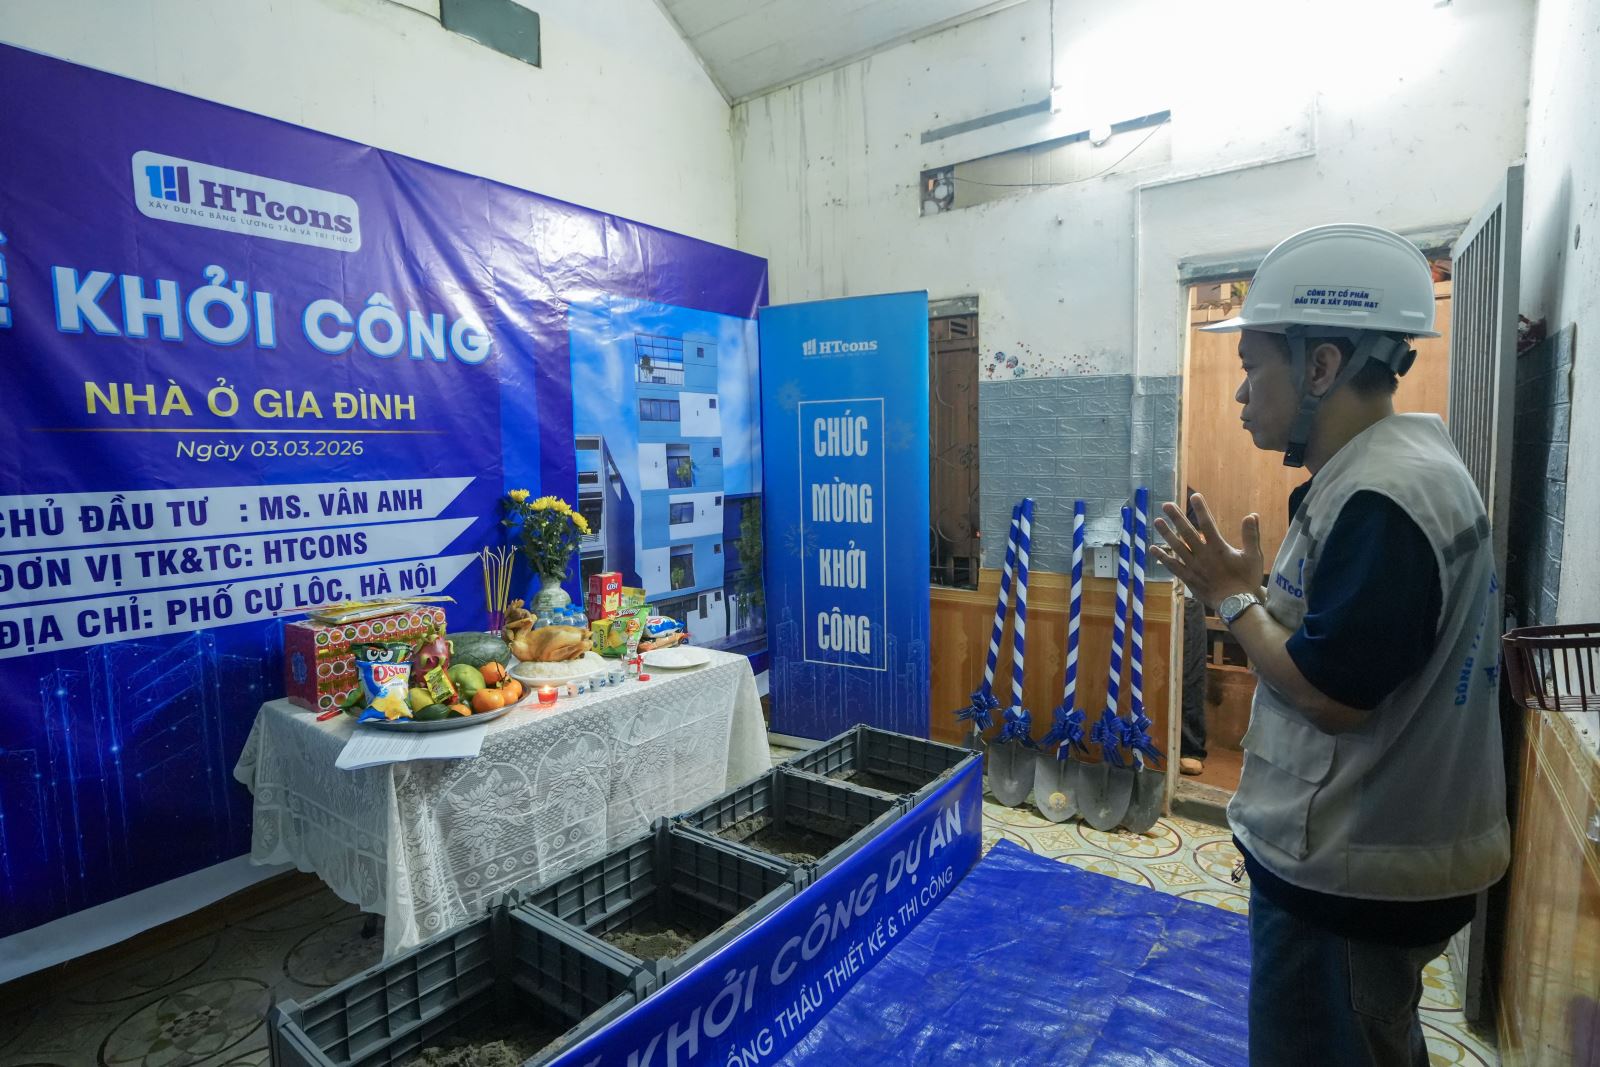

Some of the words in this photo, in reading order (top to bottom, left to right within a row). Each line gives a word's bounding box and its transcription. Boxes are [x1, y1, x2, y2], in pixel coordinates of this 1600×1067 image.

[198, 178, 353, 234] HTcons
[52, 264, 277, 349] KHỞI
[303, 292, 493, 365] CÔNG
[1306, 288, 1326, 297] CÔNG
[818, 339, 878, 354] HTcons
[84, 379, 194, 418] NHÀ
[206, 377, 240, 418] Ở
[253, 387, 323, 420] GIA
[332, 388, 416, 421] ĐÌNH
[176, 440, 245, 463] Ngày
[250, 440, 364, 458] 03.03.2026
[813, 409, 869, 458] CHÚC
[0, 498, 64, 538] HỦ
[79, 494, 155, 533] ĐẦU
[167, 496, 210, 527] TƯ
[259, 495, 310, 521] MS.
[318, 487, 369, 516] VÂN
[377, 488, 424, 513] ANH
[811, 476, 873, 524] MỪNG
[85, 553, 123, 587] VỊ
[134, 543, 254, 579] TK&TC:
[263, 531, 368, 565] HTCONS
[818, 540, 867, 589] KHỞI
[0, 615, 64, 653] ĐỊA
[77, 595, 153, 638] CHỈ:
[167, 584, 234, 626] PHỐ
[245, 586, 285, 617] CỰ
[359, 567, 392, 597] HÀ
[399, 562, 437, 593] NỘI
[817, 605, 871, 655] CÔNG
[770, 873, 879, 987] CÔNG
[885, 835, 925, 885] DỰ
[928, 800, 963, 858] ÁN
[774, 984, 823, 1039] THẦU
[823, 940, 865, 994] THIẾT
[867, 917, 887, 957] KẾ
[888, 915, 899, 939] &
[898, 895, 919, 928] THI
[920, 866, 953, 907] CÔNG
